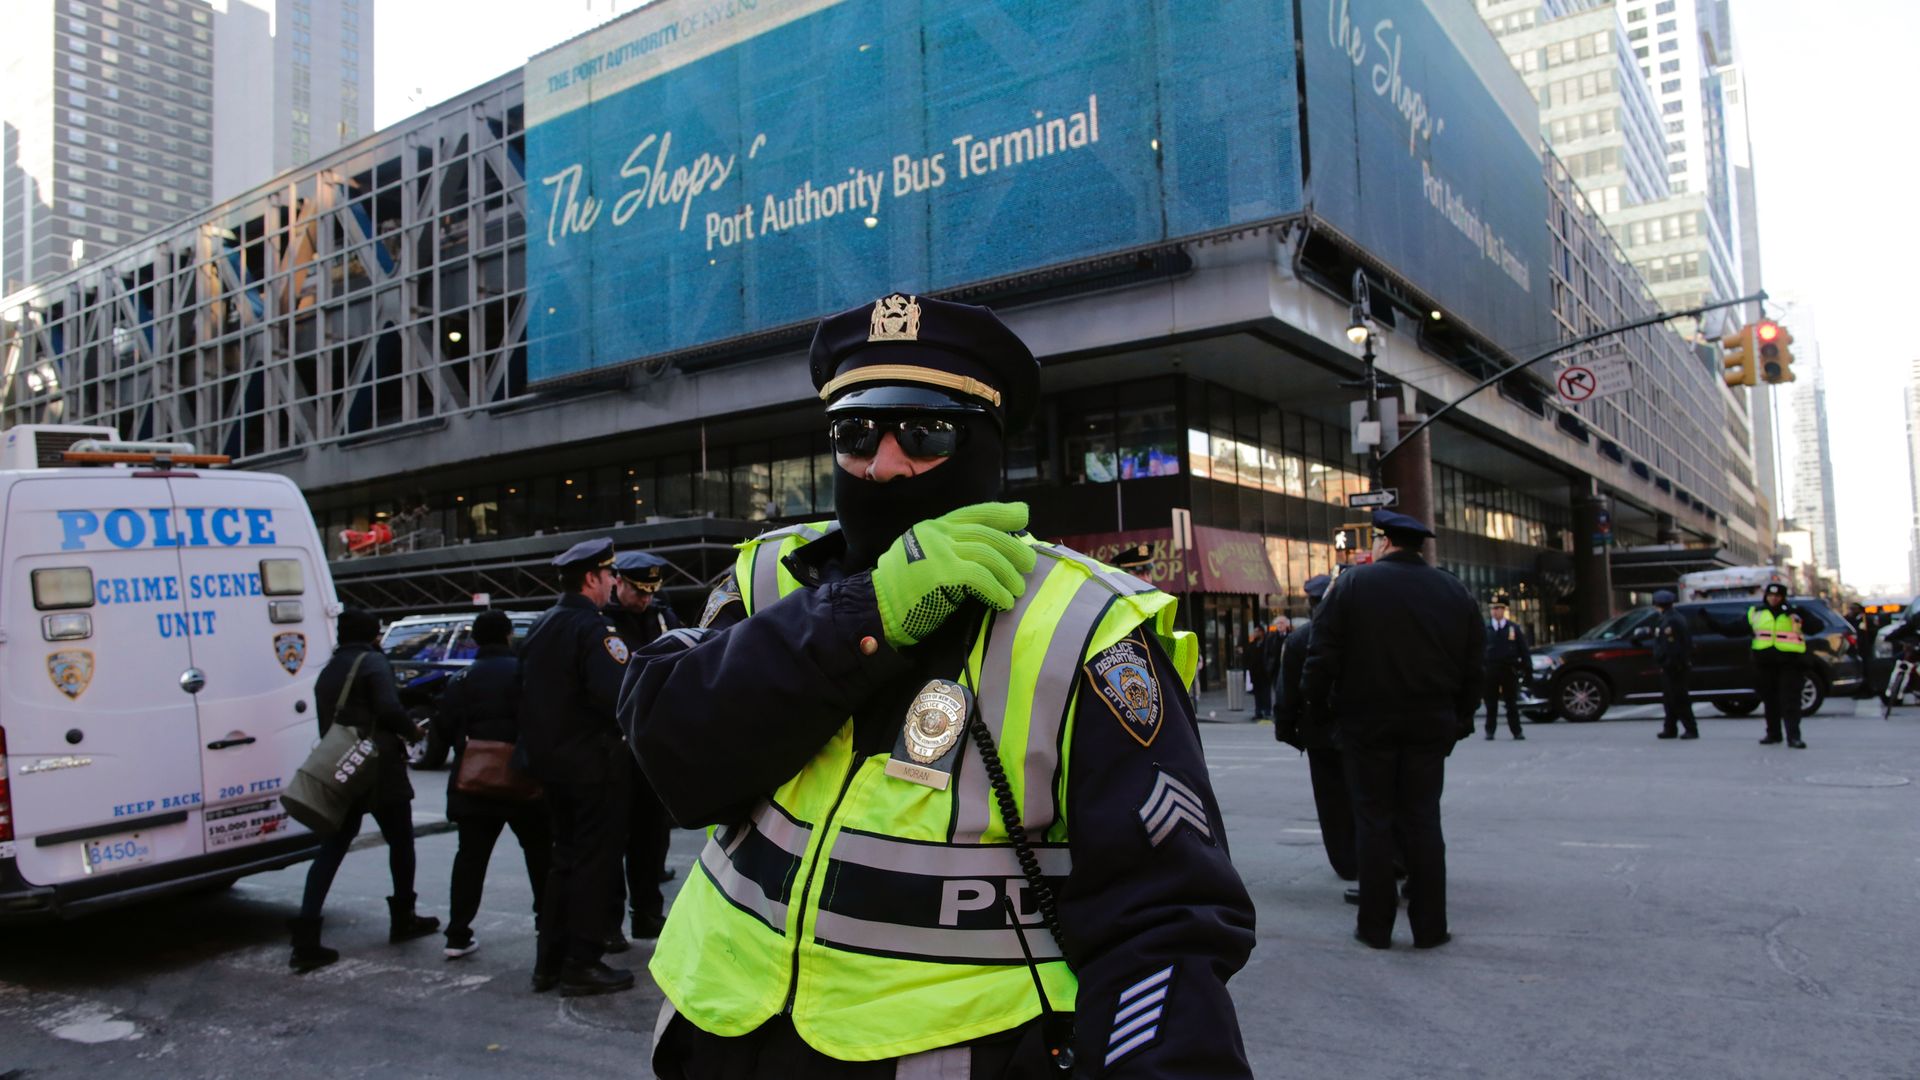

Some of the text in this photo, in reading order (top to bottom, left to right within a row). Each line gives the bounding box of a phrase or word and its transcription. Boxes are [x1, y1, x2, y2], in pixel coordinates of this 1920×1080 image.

[547, 70, 570, 93] THE
[571, 55, 605, 83] PORT
[606, 22, 680, 70] AUTHORITY
[680, 15, 699, 38] OF
[1371, 18, 1433, 156] Shops
[541, 131, 736, 246] The Shops
[705, 93, 1099, 251] Port Authority Bus Terminal
[1422, 160, 1445, 216] Port
[56, 508, 276, 550] POLICE
[95, 572, 263, 605] CRIME SCENE
[157, 610, 217, 638] UNIT
[1095, 652, 1148, 676] DEPARTMENT
[1103, 642, 1135, 657] POLICE
[917, 702, 956, 719] POLICE DEPT
[1103, 686, 1126, 709] CITY
[1125, 710, 1138, 723] OF
[1148, 703, 1159, 727] NEW
[904, 767, 930, 780] MORAN
[113, 777, 282, 817] KEEP BACK 200 FEET
[90, 840, 136, 864] 8450
[938, 878, 1052, 926] PD
